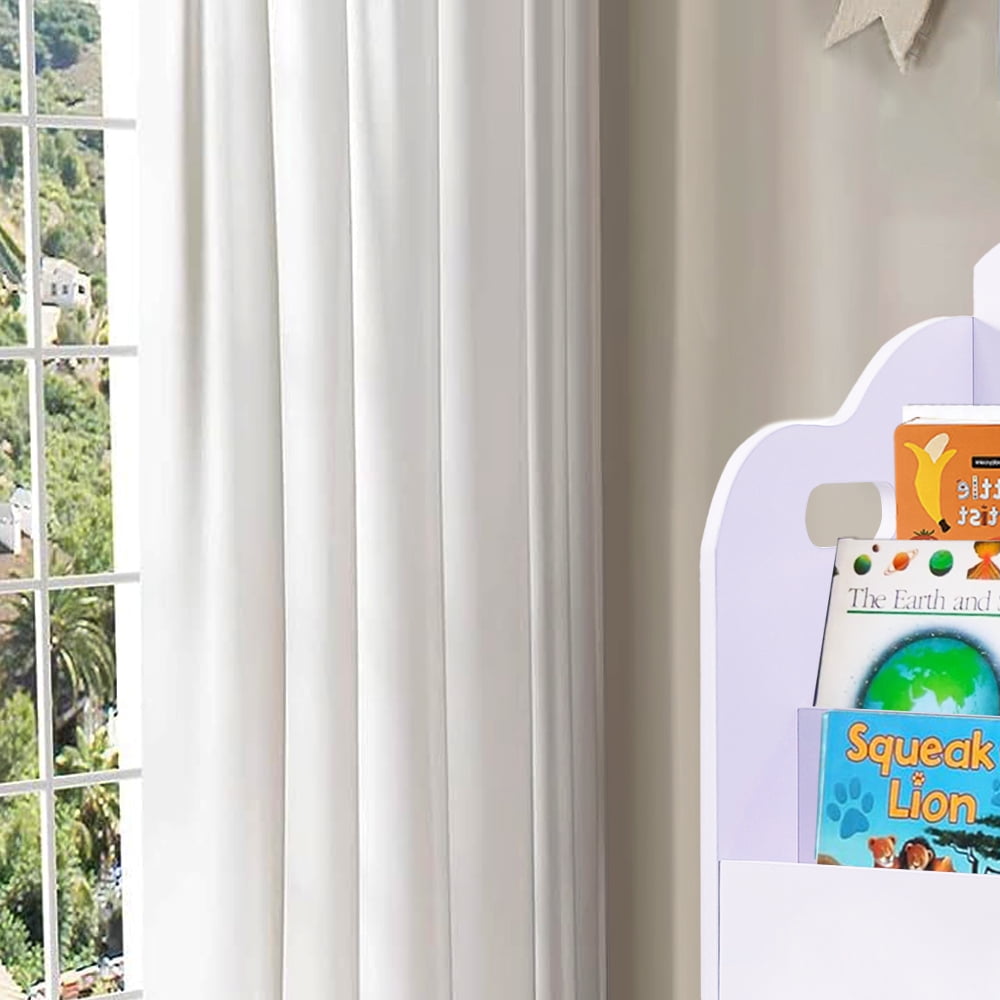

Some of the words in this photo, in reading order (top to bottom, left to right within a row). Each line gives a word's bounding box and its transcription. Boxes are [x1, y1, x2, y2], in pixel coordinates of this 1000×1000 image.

[848, 587, 886, 609] The
[894, 588, 945, 610] Earth
[953, 590, 991, 612] and
[846, 721, 996, 777] Squeak
[888, 771, 977, 824] Lion
